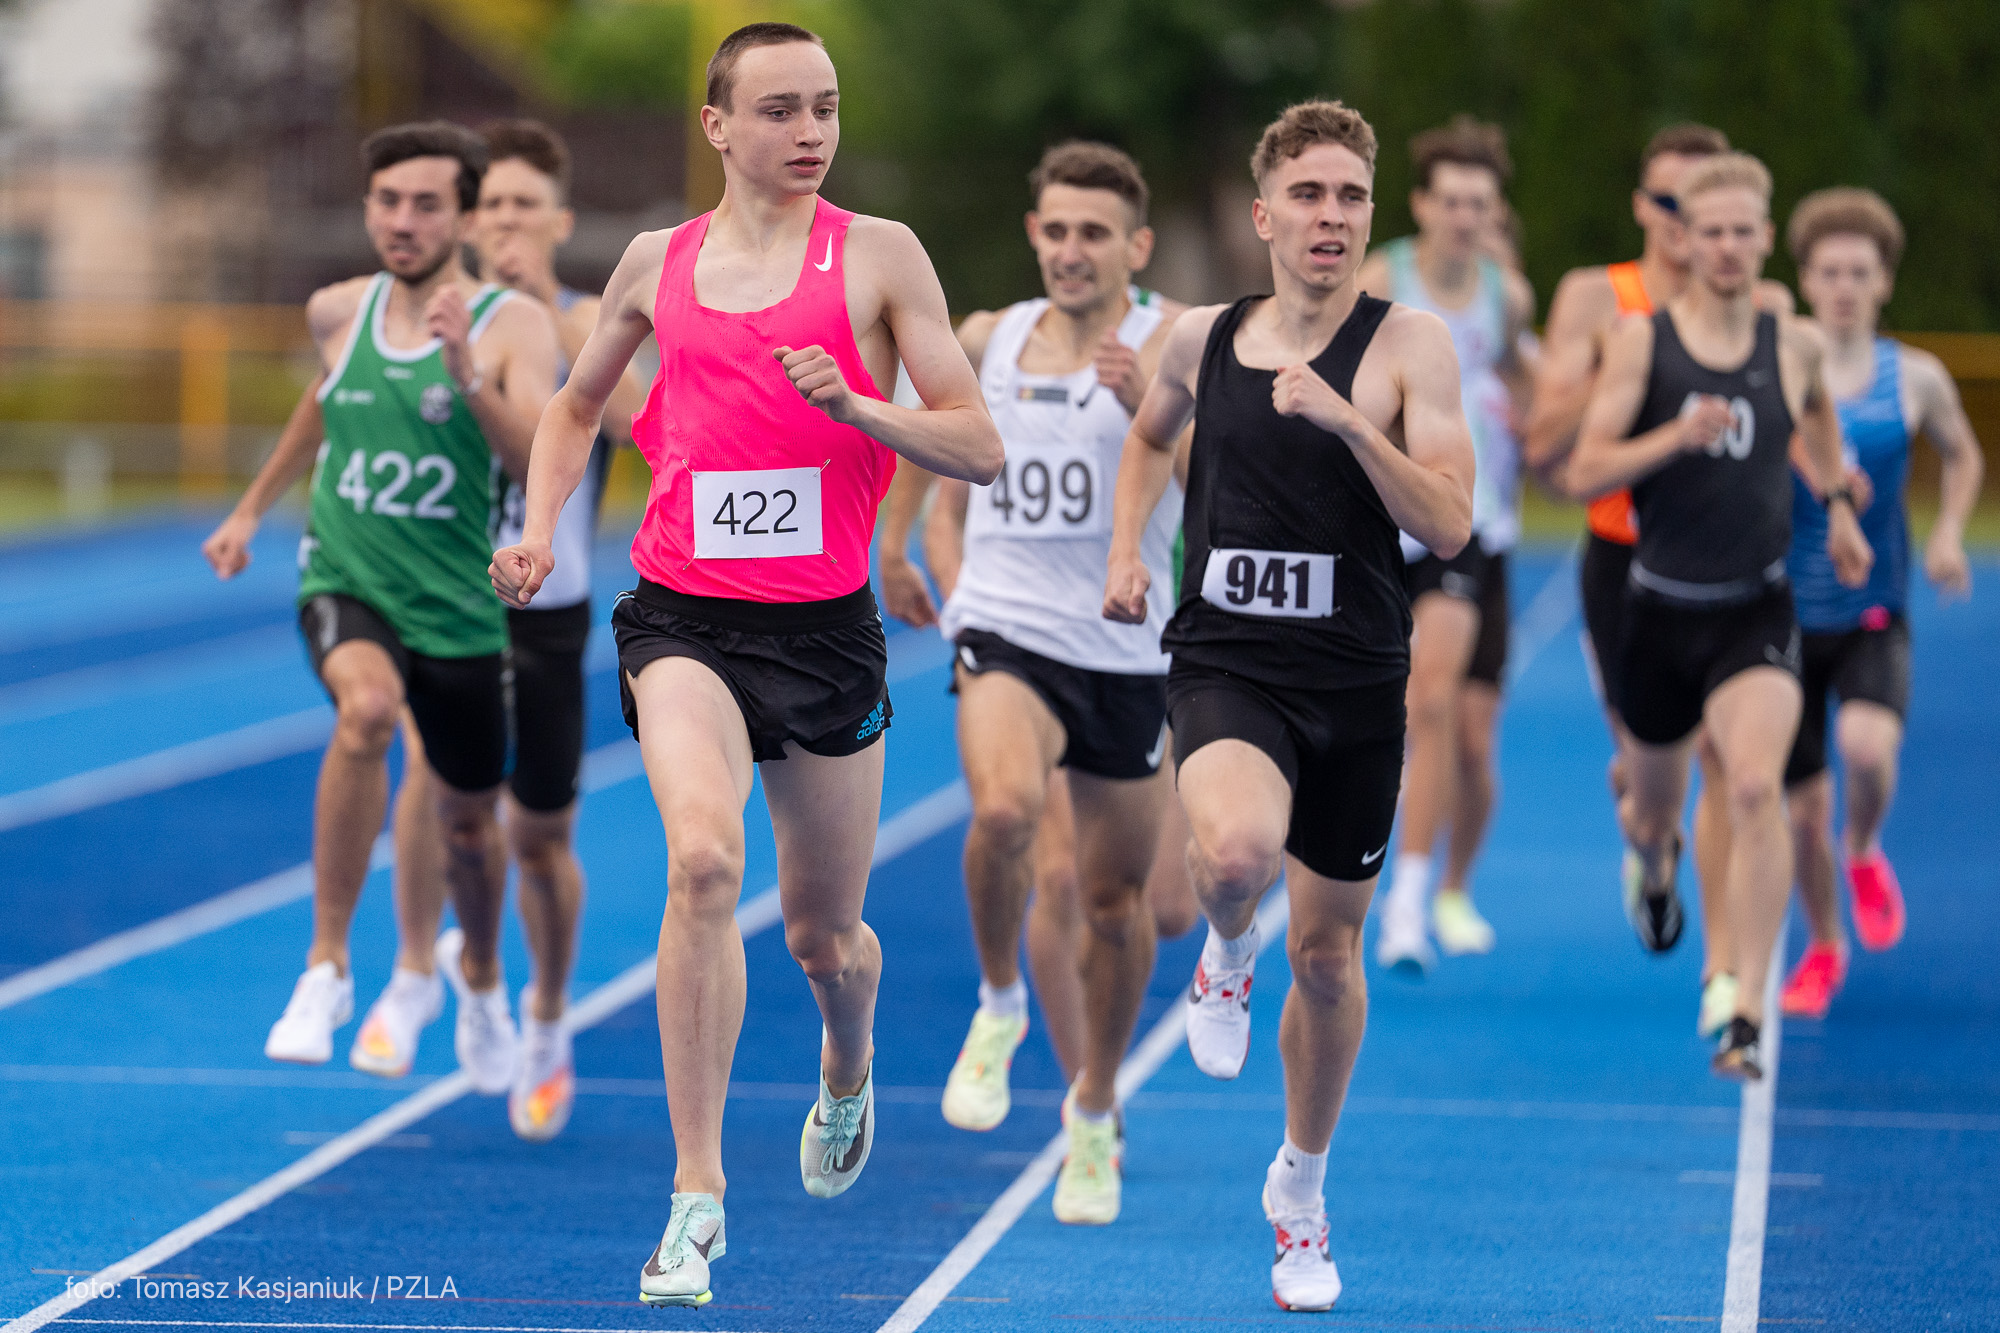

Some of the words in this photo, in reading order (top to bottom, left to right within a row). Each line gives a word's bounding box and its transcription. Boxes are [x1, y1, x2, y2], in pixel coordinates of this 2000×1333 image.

[336, 449, 457, 519] 422
[991, 457, 1093, 525] 499
[712, 489, 799, 536] 422
[1225, 555, 1310, 610] 941
[856, 715, 885, 740] adida
